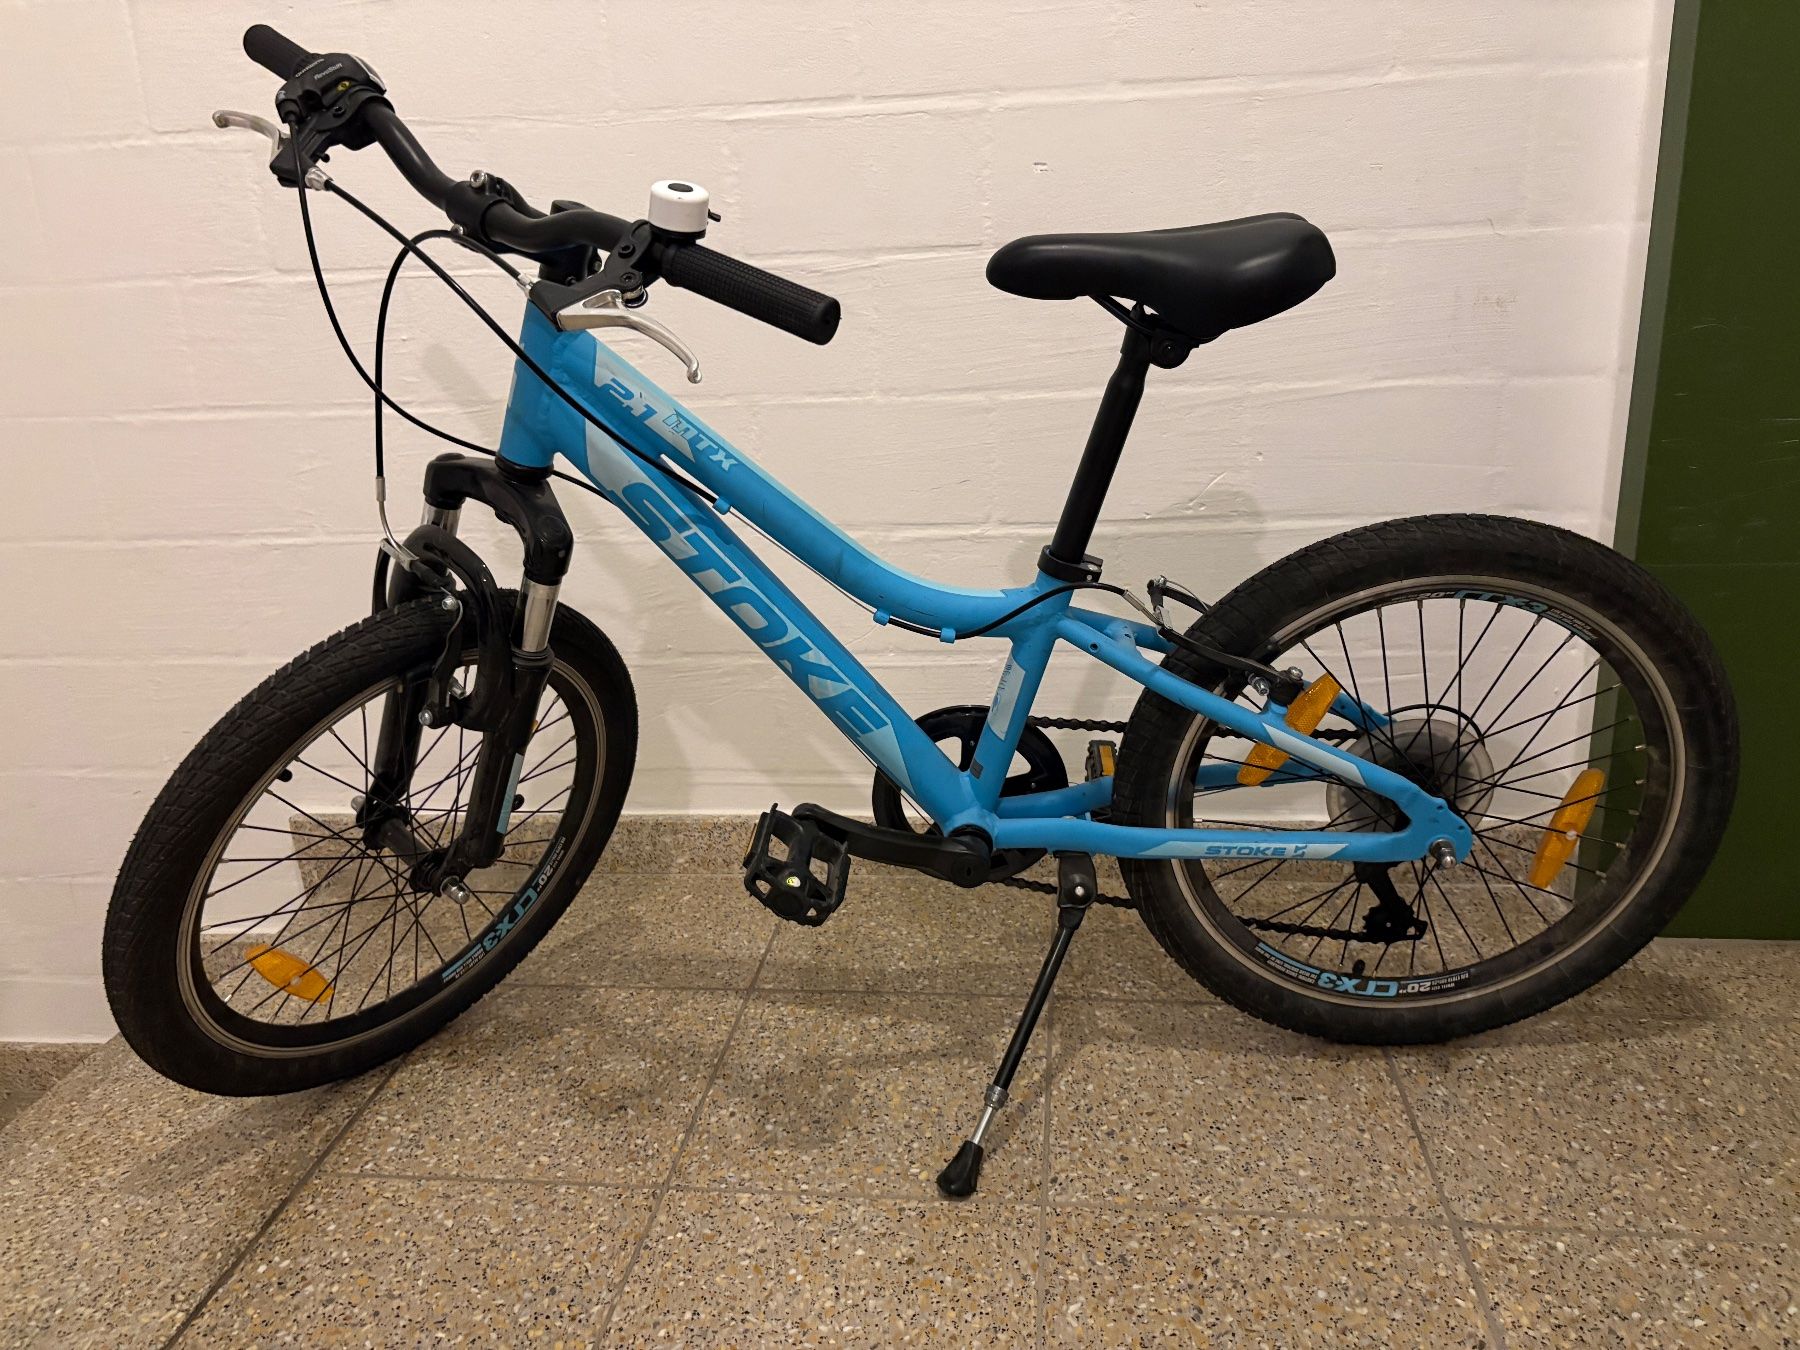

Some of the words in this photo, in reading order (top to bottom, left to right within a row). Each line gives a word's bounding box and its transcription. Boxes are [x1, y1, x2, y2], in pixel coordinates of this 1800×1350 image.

[600, 377, 658, 424] 2.1
[662, 412, 738, 472] MTX
[611, 482, 890, 742] STOKE
[1204, 845, 1287, 857] STOKE
